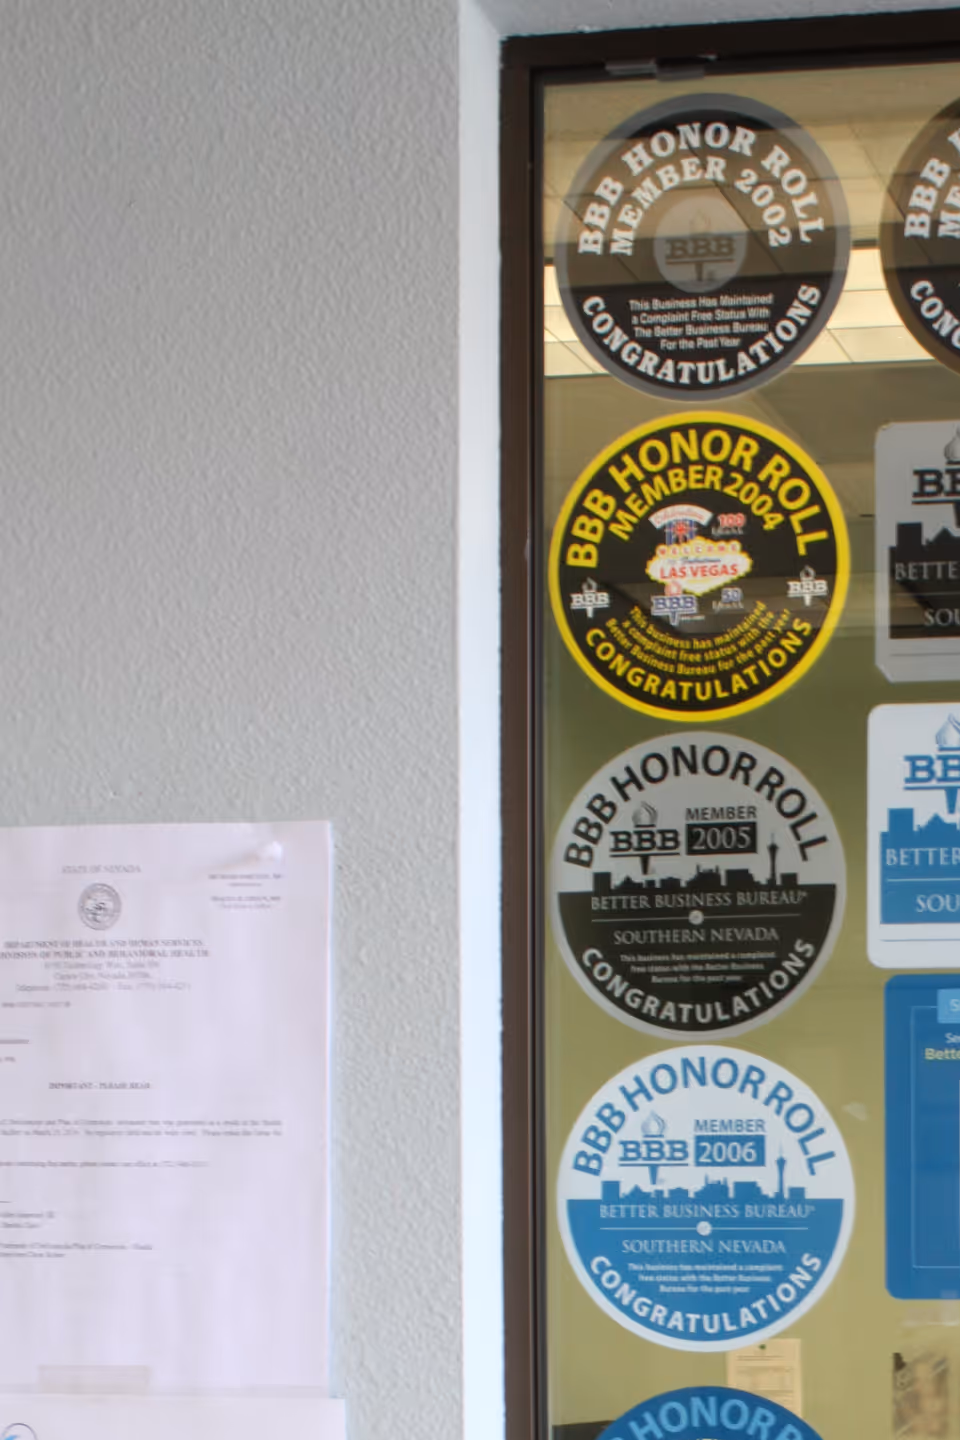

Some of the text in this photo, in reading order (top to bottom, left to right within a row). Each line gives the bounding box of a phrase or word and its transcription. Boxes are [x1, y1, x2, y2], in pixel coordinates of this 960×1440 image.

[578, 123, 824, 255] BBB HONOR ROLL
[610, 157, 791, 256] MEMBER 2002
[904, 158, 950, 238] BBB
[583, 285, 820, 384] CONGRATULATIONS
[652, 298, 696, 310] Business
[720, 294, 773, 306] Maintained
[686, 324, 731, 335] Business
[567, 429, 829, 568] BBB HONOR ROLL
[609, 465, 784, 541] MEMBER 2004
[586, 618, 811, 700] CONGRATULATIONS
[564, 745, 828, 868] BBB HONOR ROLL
[609, 830, 679, 852] BBB
[686, 806, 756, 820] MEMBER
[692, 827, 750, 850] 2005
[614, 928, 779, 944] SOUTHERN NEVADA
[582, 939, 814, 1024] CONGRATULATIONS
[572, 1056, 835, 1176] BBB HONOR ROLL
[619, 1140, 688, 1161] BBB
[694, 1120, 765, 1132] MEMBER
[699, 1142, 757, 1162] 2006
[622, 1240, 786, 1253] SOUTHERN NEVADA
[590, 1253, 821, 1334] CONGRATULATIONS
